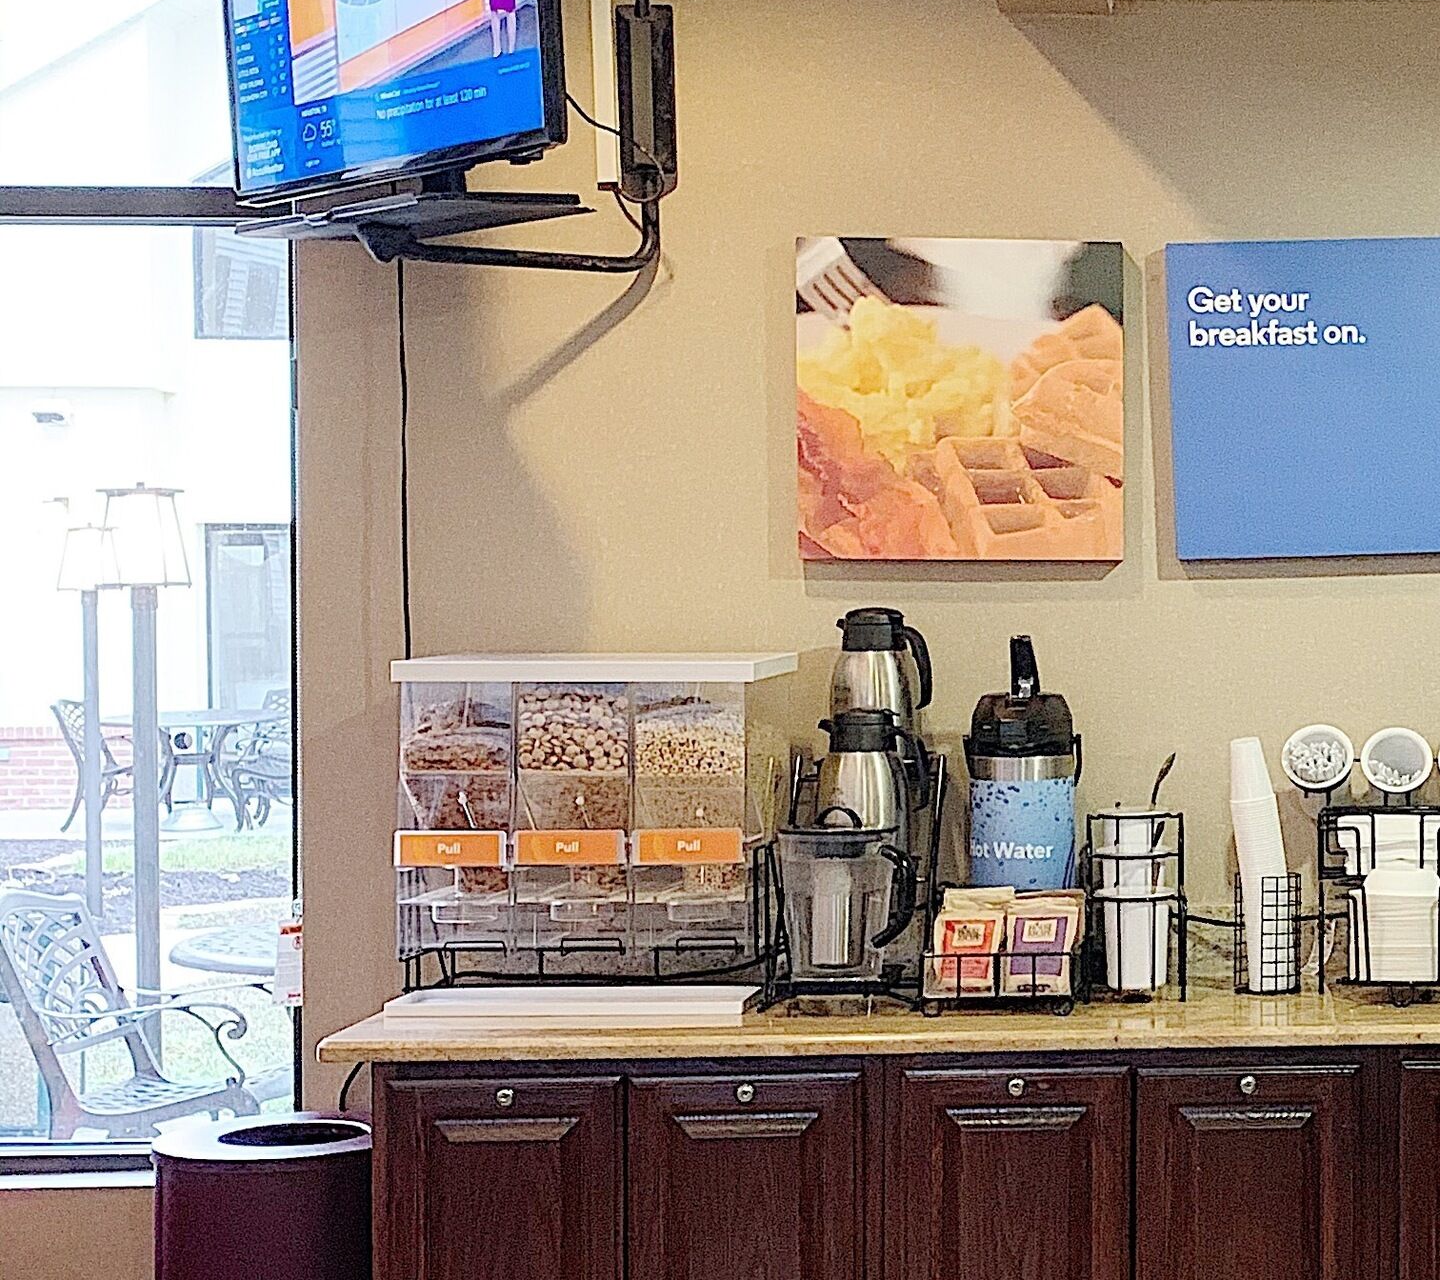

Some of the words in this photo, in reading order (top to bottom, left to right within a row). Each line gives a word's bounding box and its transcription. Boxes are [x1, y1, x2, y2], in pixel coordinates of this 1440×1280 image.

[1187, 286, 1243, 313] Get
[1247, 292, 1310, 318] your
[1189, 319, 1318, 347] breakfast
[1323, 324, 1367, 344] on.
[436, 841, 461, 855] Pull
[555, 840, 580, 853] Pull
[676, 838, 701, 852] Pull
[992, 841, 1054, 859] Water
